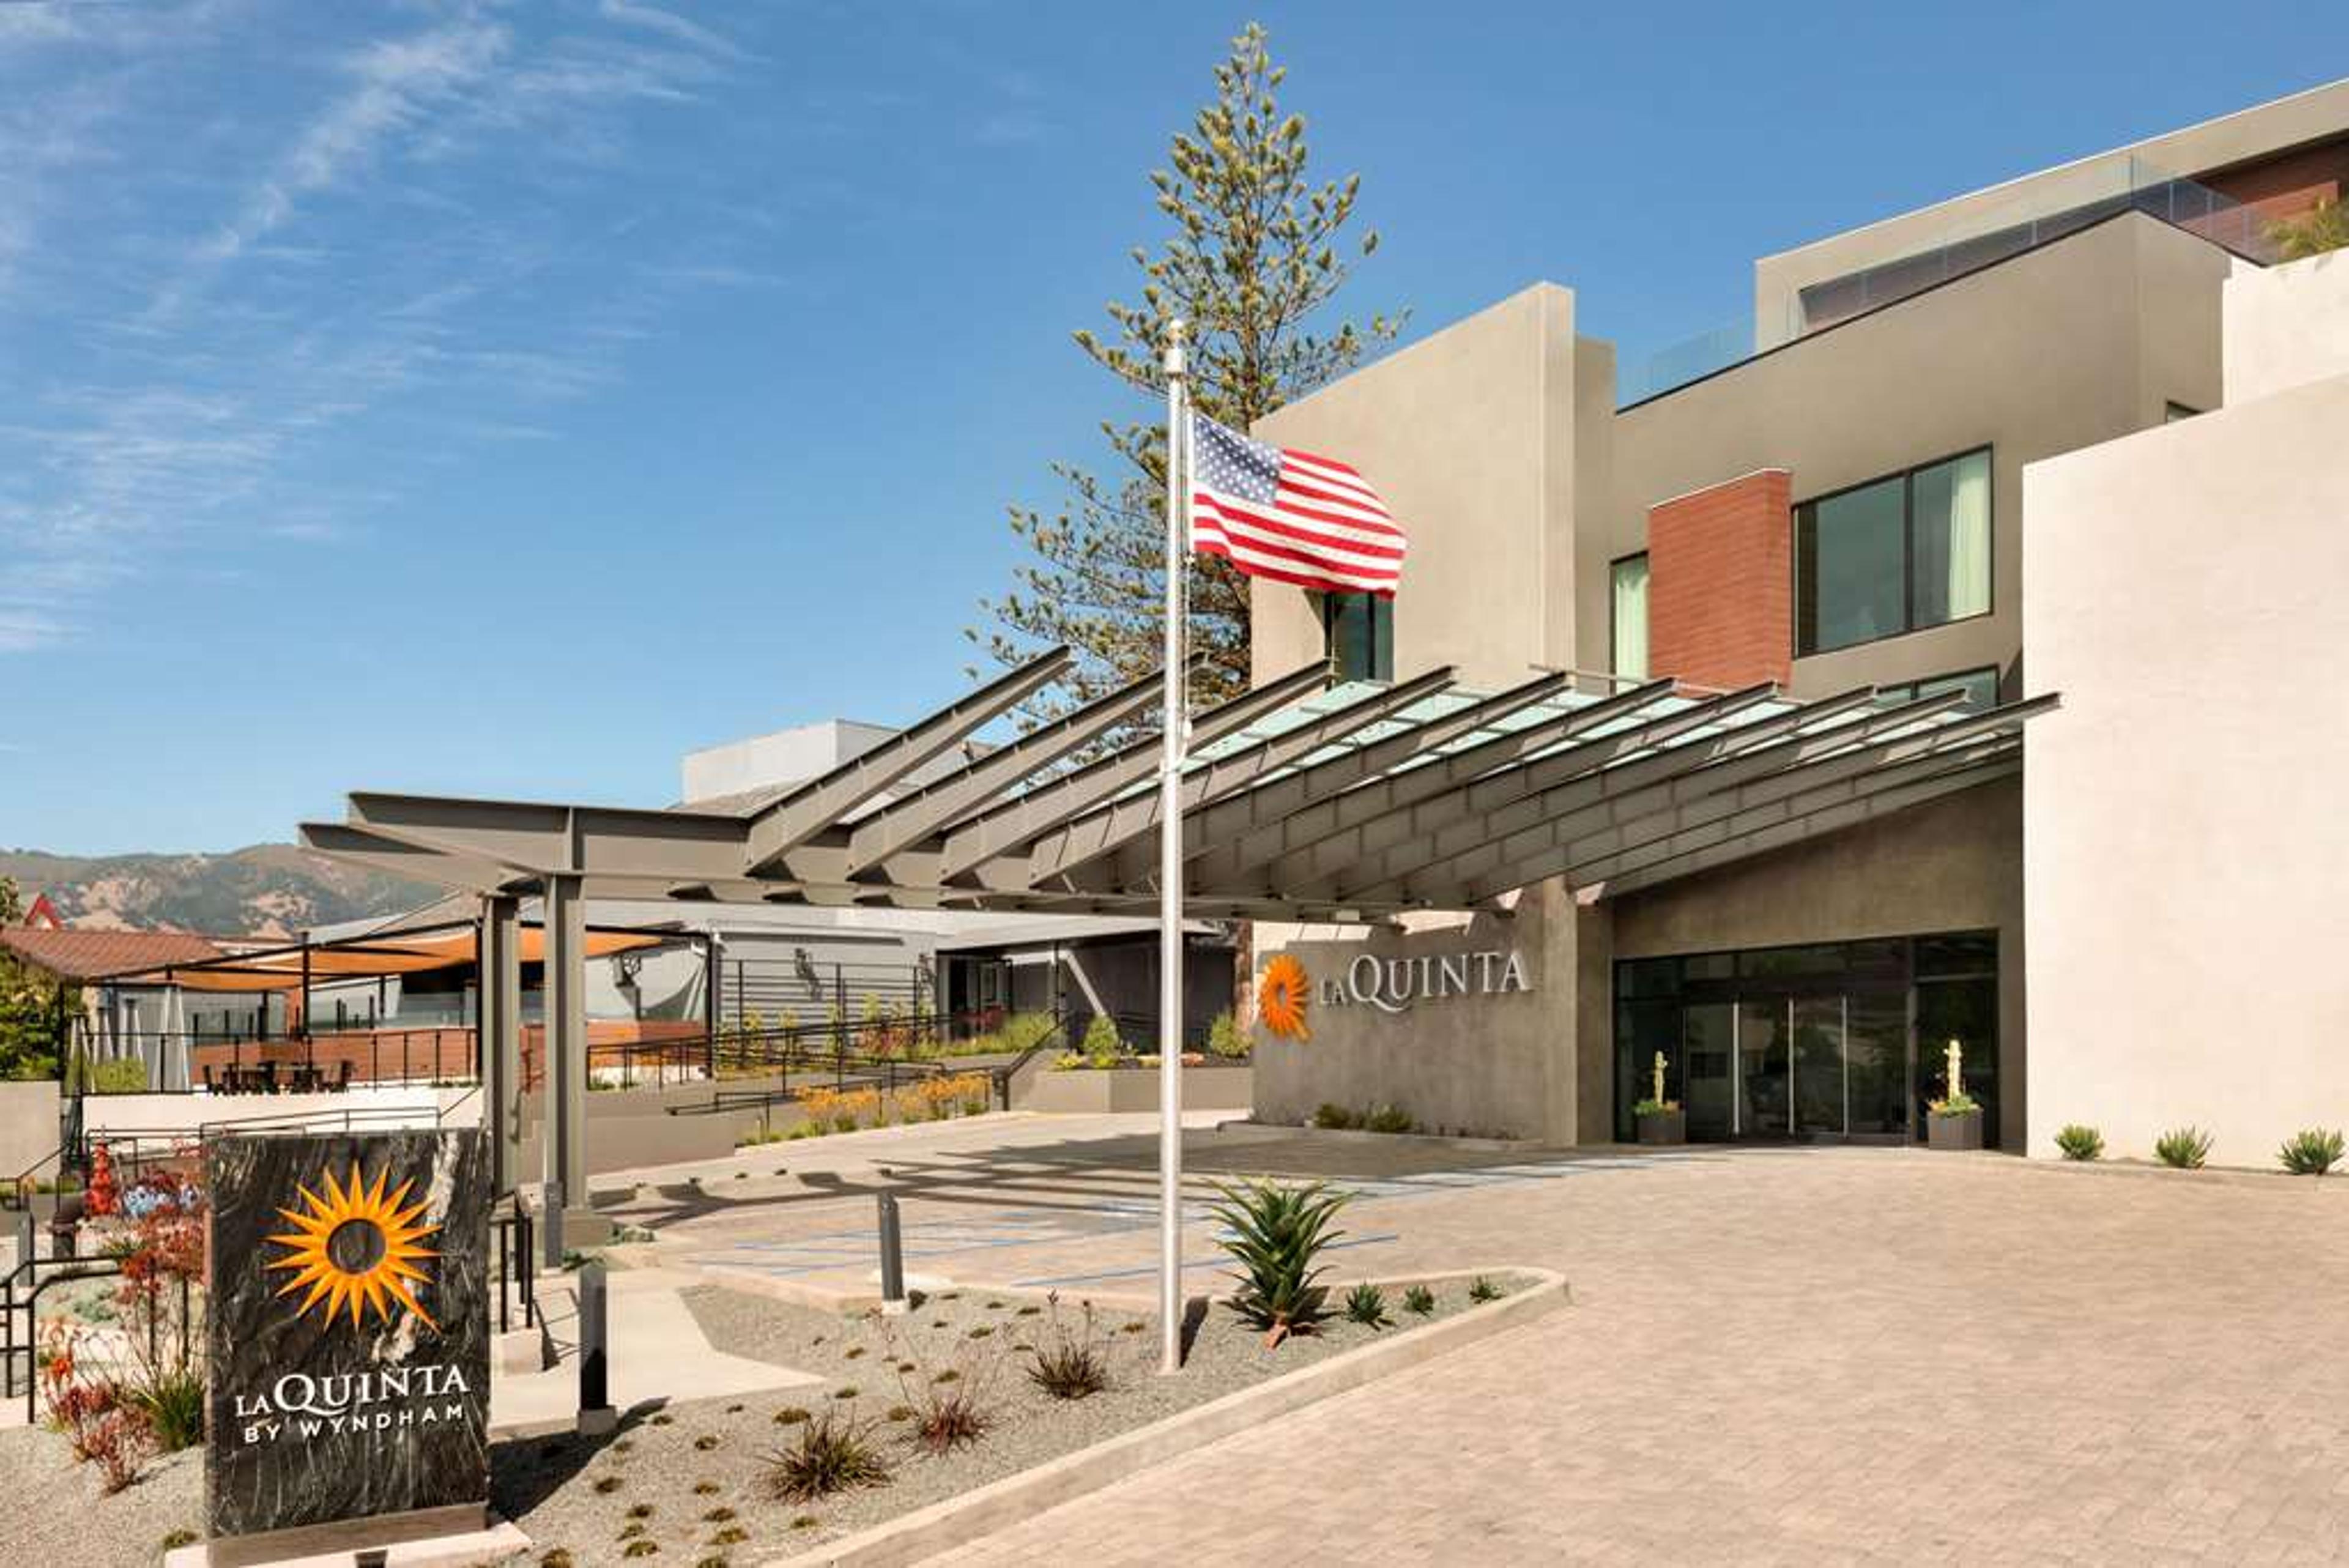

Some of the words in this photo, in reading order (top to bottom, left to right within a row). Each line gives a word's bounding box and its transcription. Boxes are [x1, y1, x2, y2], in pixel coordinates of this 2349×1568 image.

[1319, 979, 1346, 1005] LA
[1349, 950, 1531, 1012] QUINTA
[235, 1395, 273, 1418] LA
[274, 1364, 470, 1416] QUINTA
[244, 1424, 281, 1444] BY
[300, 1404, 463, 1438] WYNDHAM
